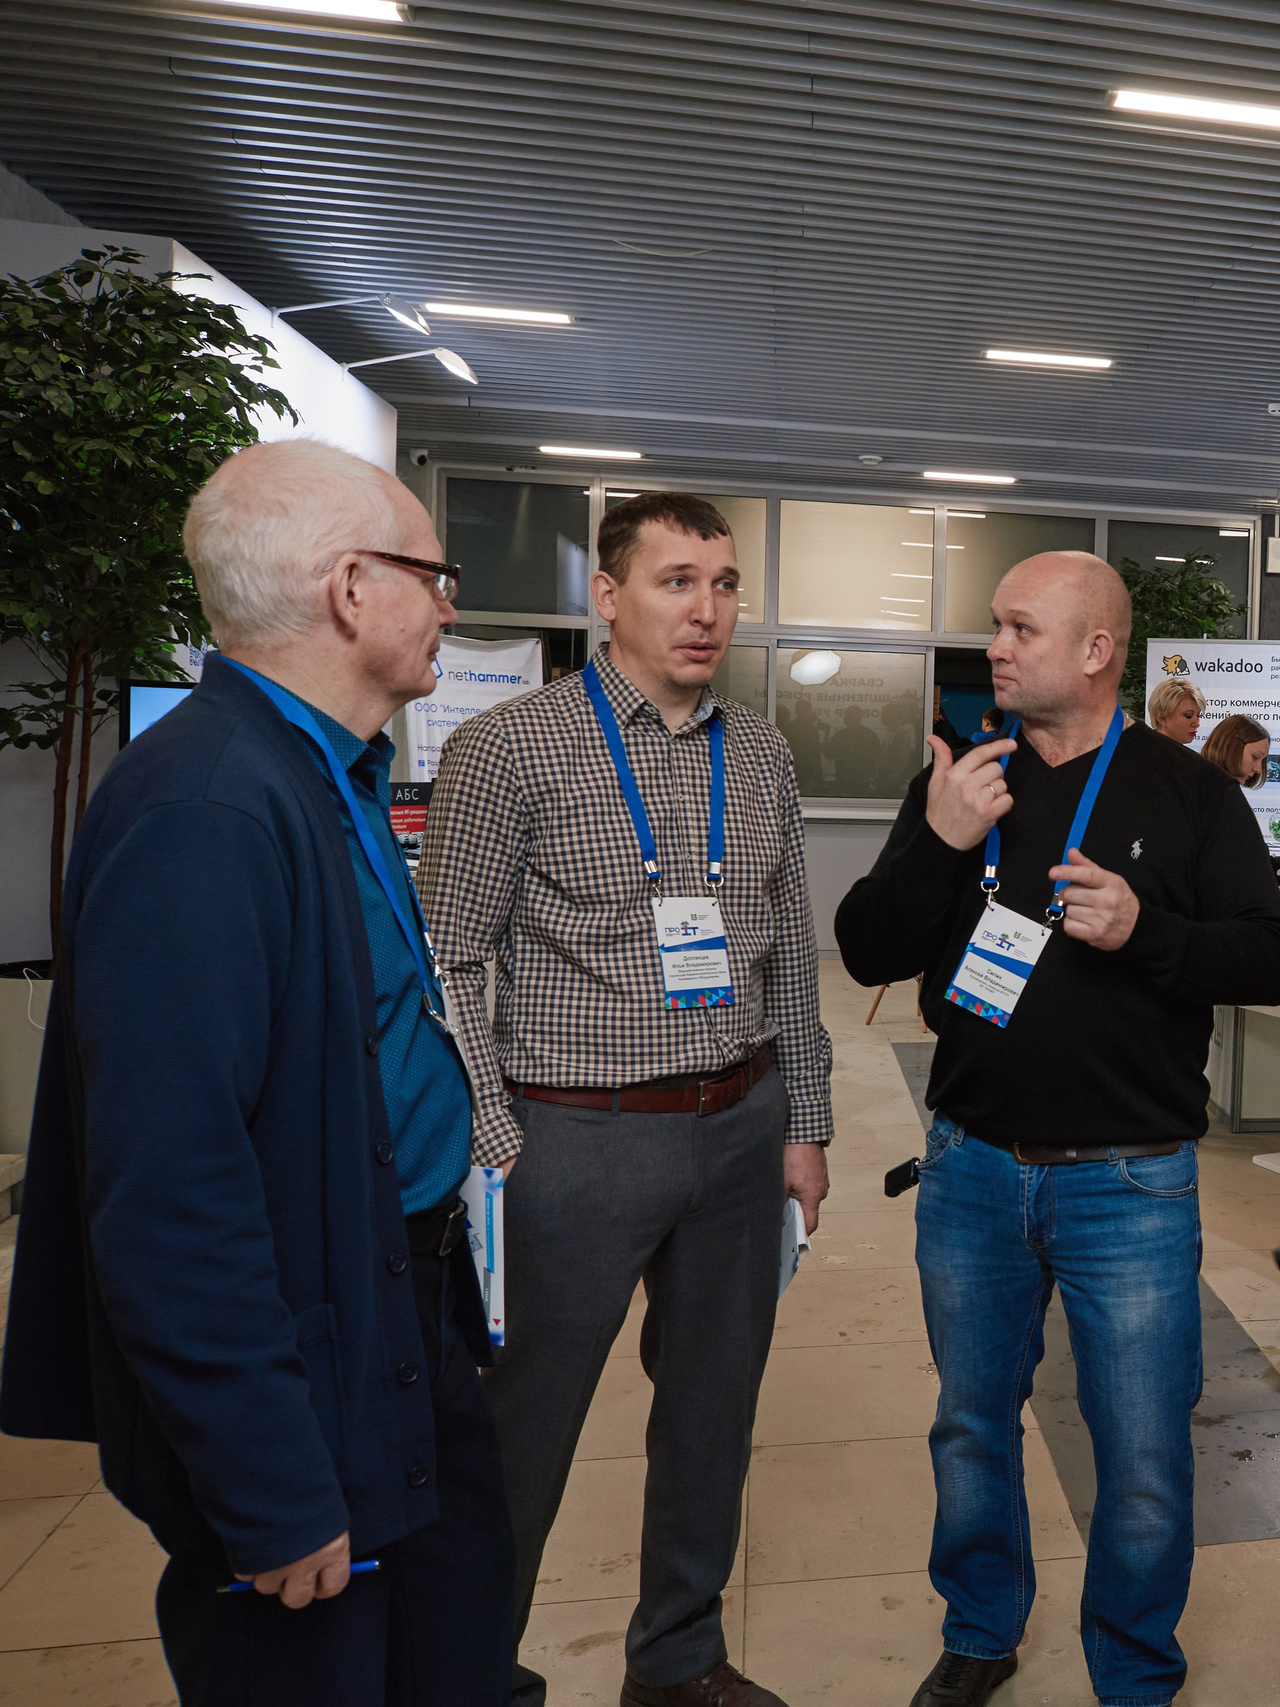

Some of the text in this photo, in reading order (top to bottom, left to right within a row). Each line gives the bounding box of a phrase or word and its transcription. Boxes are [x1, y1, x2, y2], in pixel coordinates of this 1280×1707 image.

[1195, 658, 1263, 673] wakadoo
[448, 670, 522, 684] nethammer
[415, 702, 438, 713] ООО
[395, 788, 420, 800] АБС
